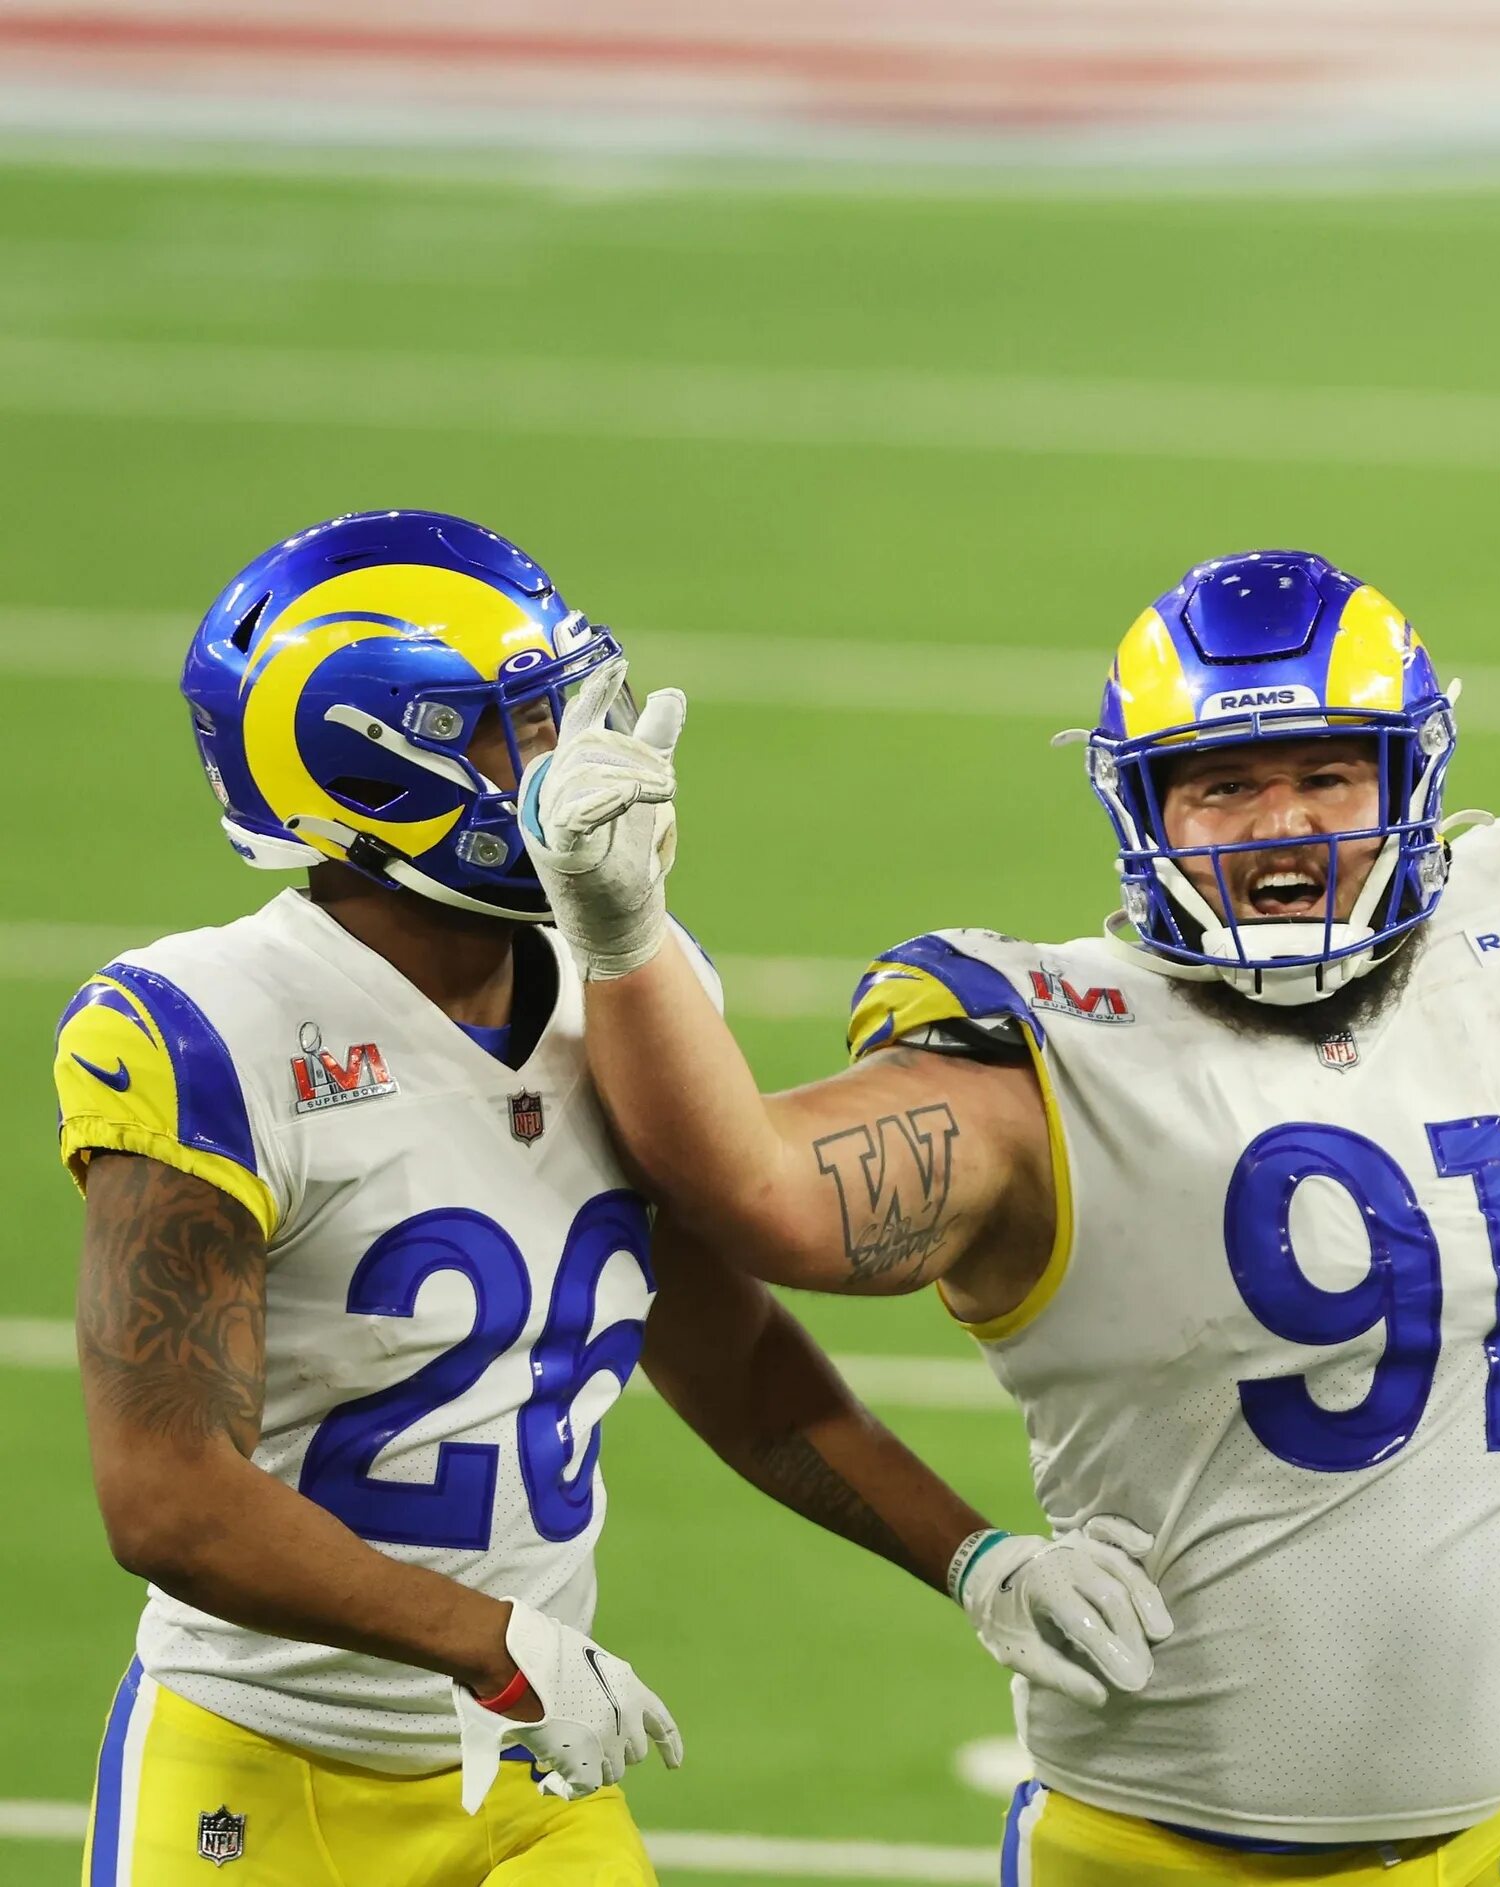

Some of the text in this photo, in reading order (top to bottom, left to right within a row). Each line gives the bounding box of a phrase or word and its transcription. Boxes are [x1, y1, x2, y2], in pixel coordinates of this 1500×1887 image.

[1220, 690, 1295, 710] RAMS
[1043, 1001, 1124, 1021] SUPER BOWL
[1324, 1042, 1355, 1062] NFL
[307, 1094, 348, 1109] SUPER
[515, 1112, 541, 1135] NFL
[812, 1102, 960, 1259] W
[300, 1187, 657, 1551] 26
[204, 1832, 236, 1855] NFL
